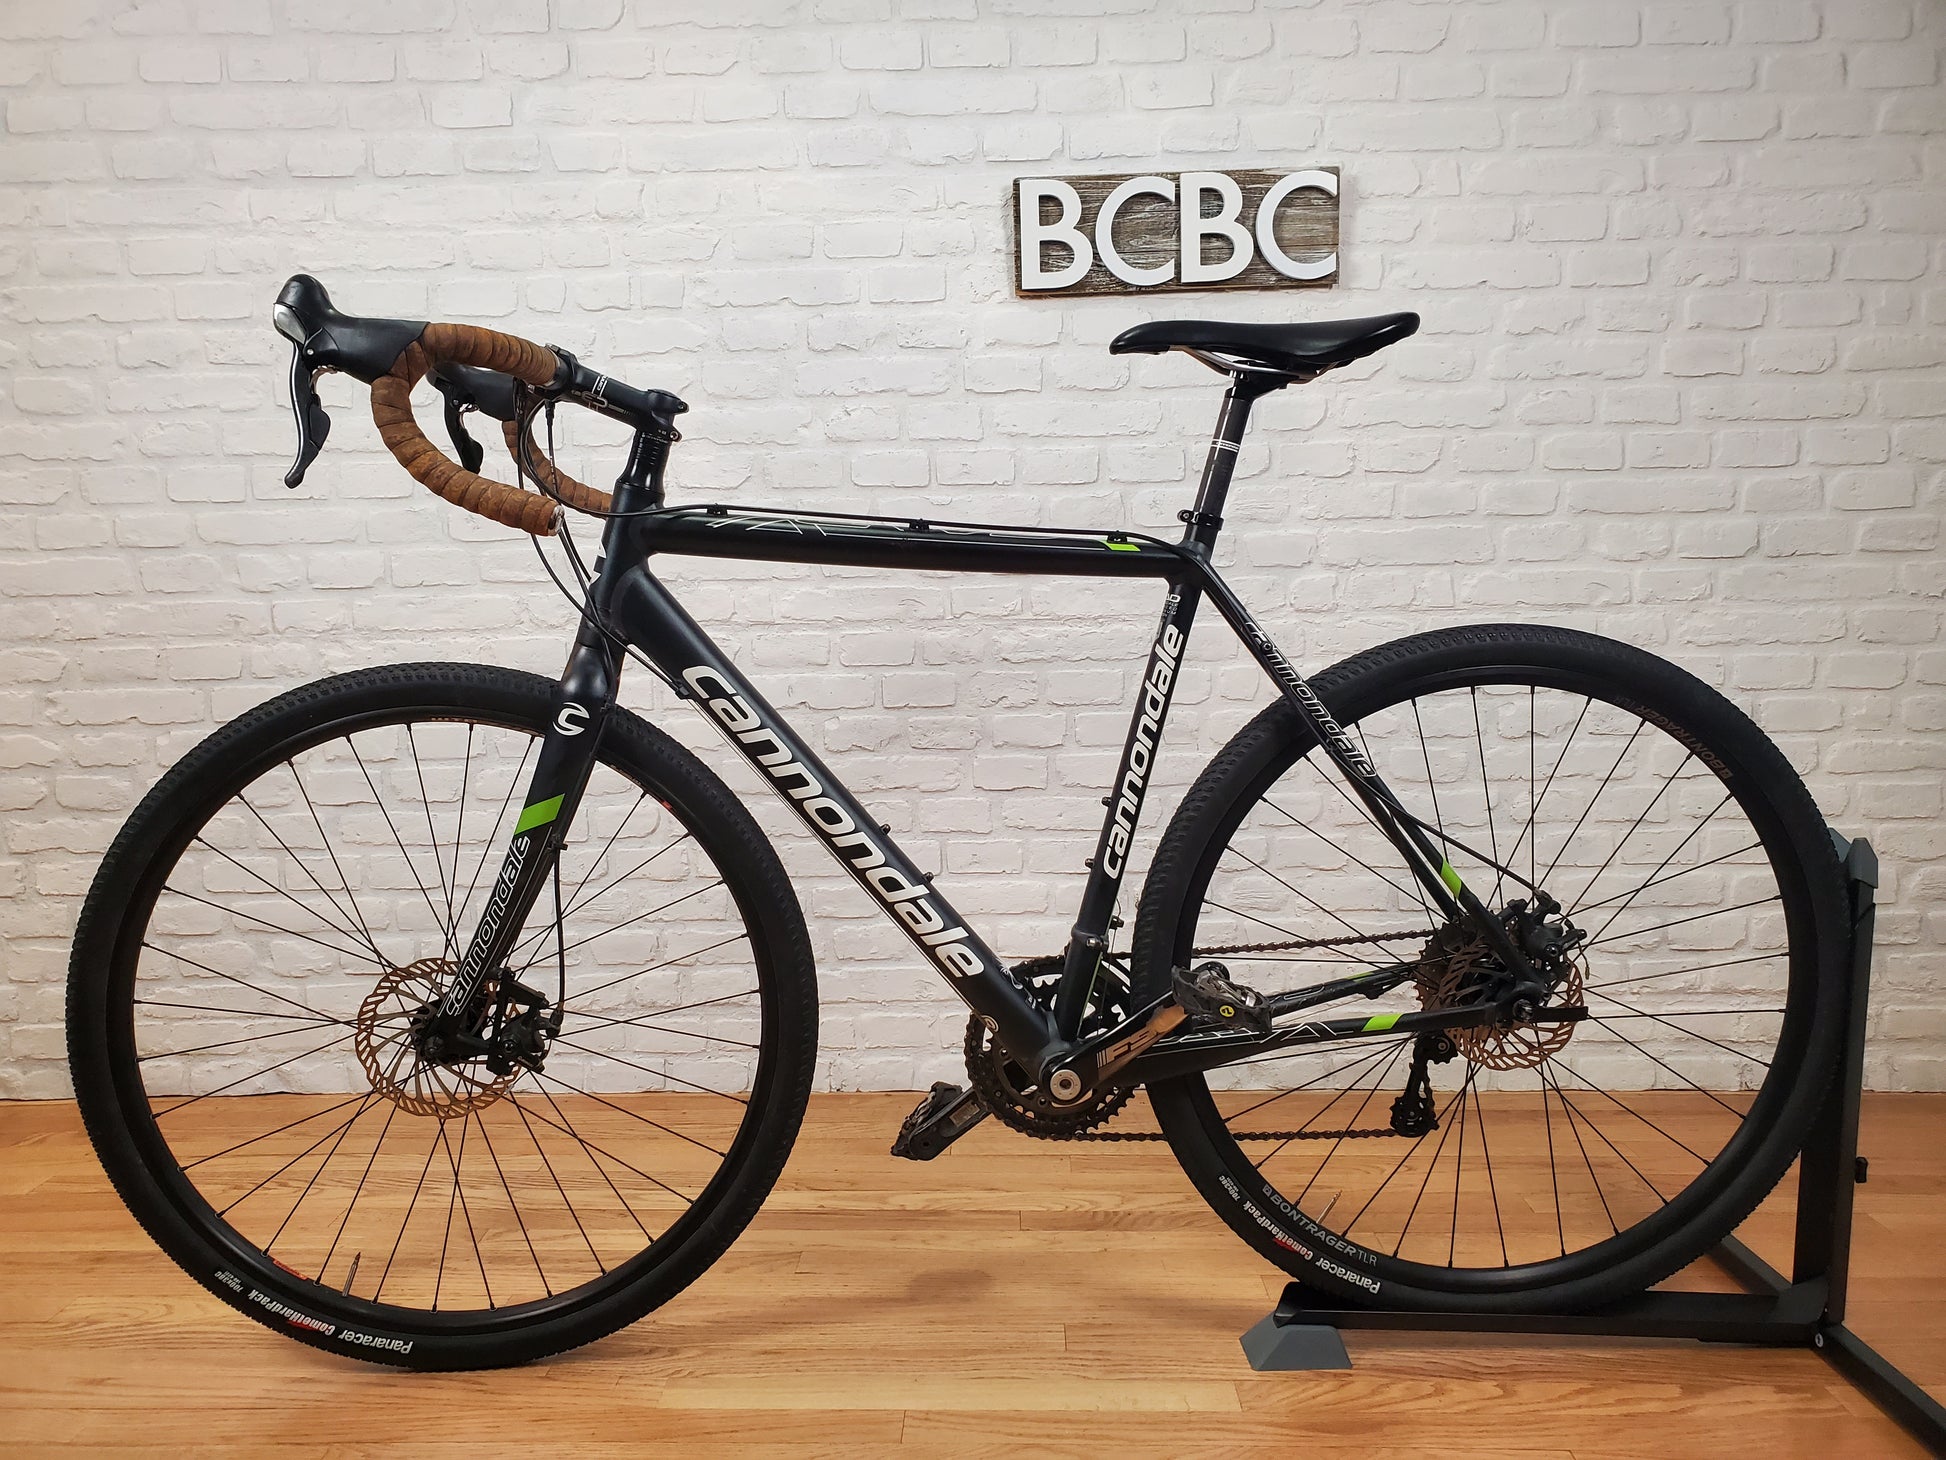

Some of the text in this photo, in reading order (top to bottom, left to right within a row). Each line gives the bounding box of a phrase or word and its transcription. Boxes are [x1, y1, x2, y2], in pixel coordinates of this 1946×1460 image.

[1019, 170, 1338, 290] BCBC
[1103, 624, 1183, 880] cannondale
[682, 665, 985, 978] cannondale
[446, 835, 530, 1016] cannondale
[1270, 1192, 1378, 1267] BONTRAGER TLR
[1315, 1256, 1381, 1294] Panaracer
[337, 1329, 414, 1355] Panaracer
